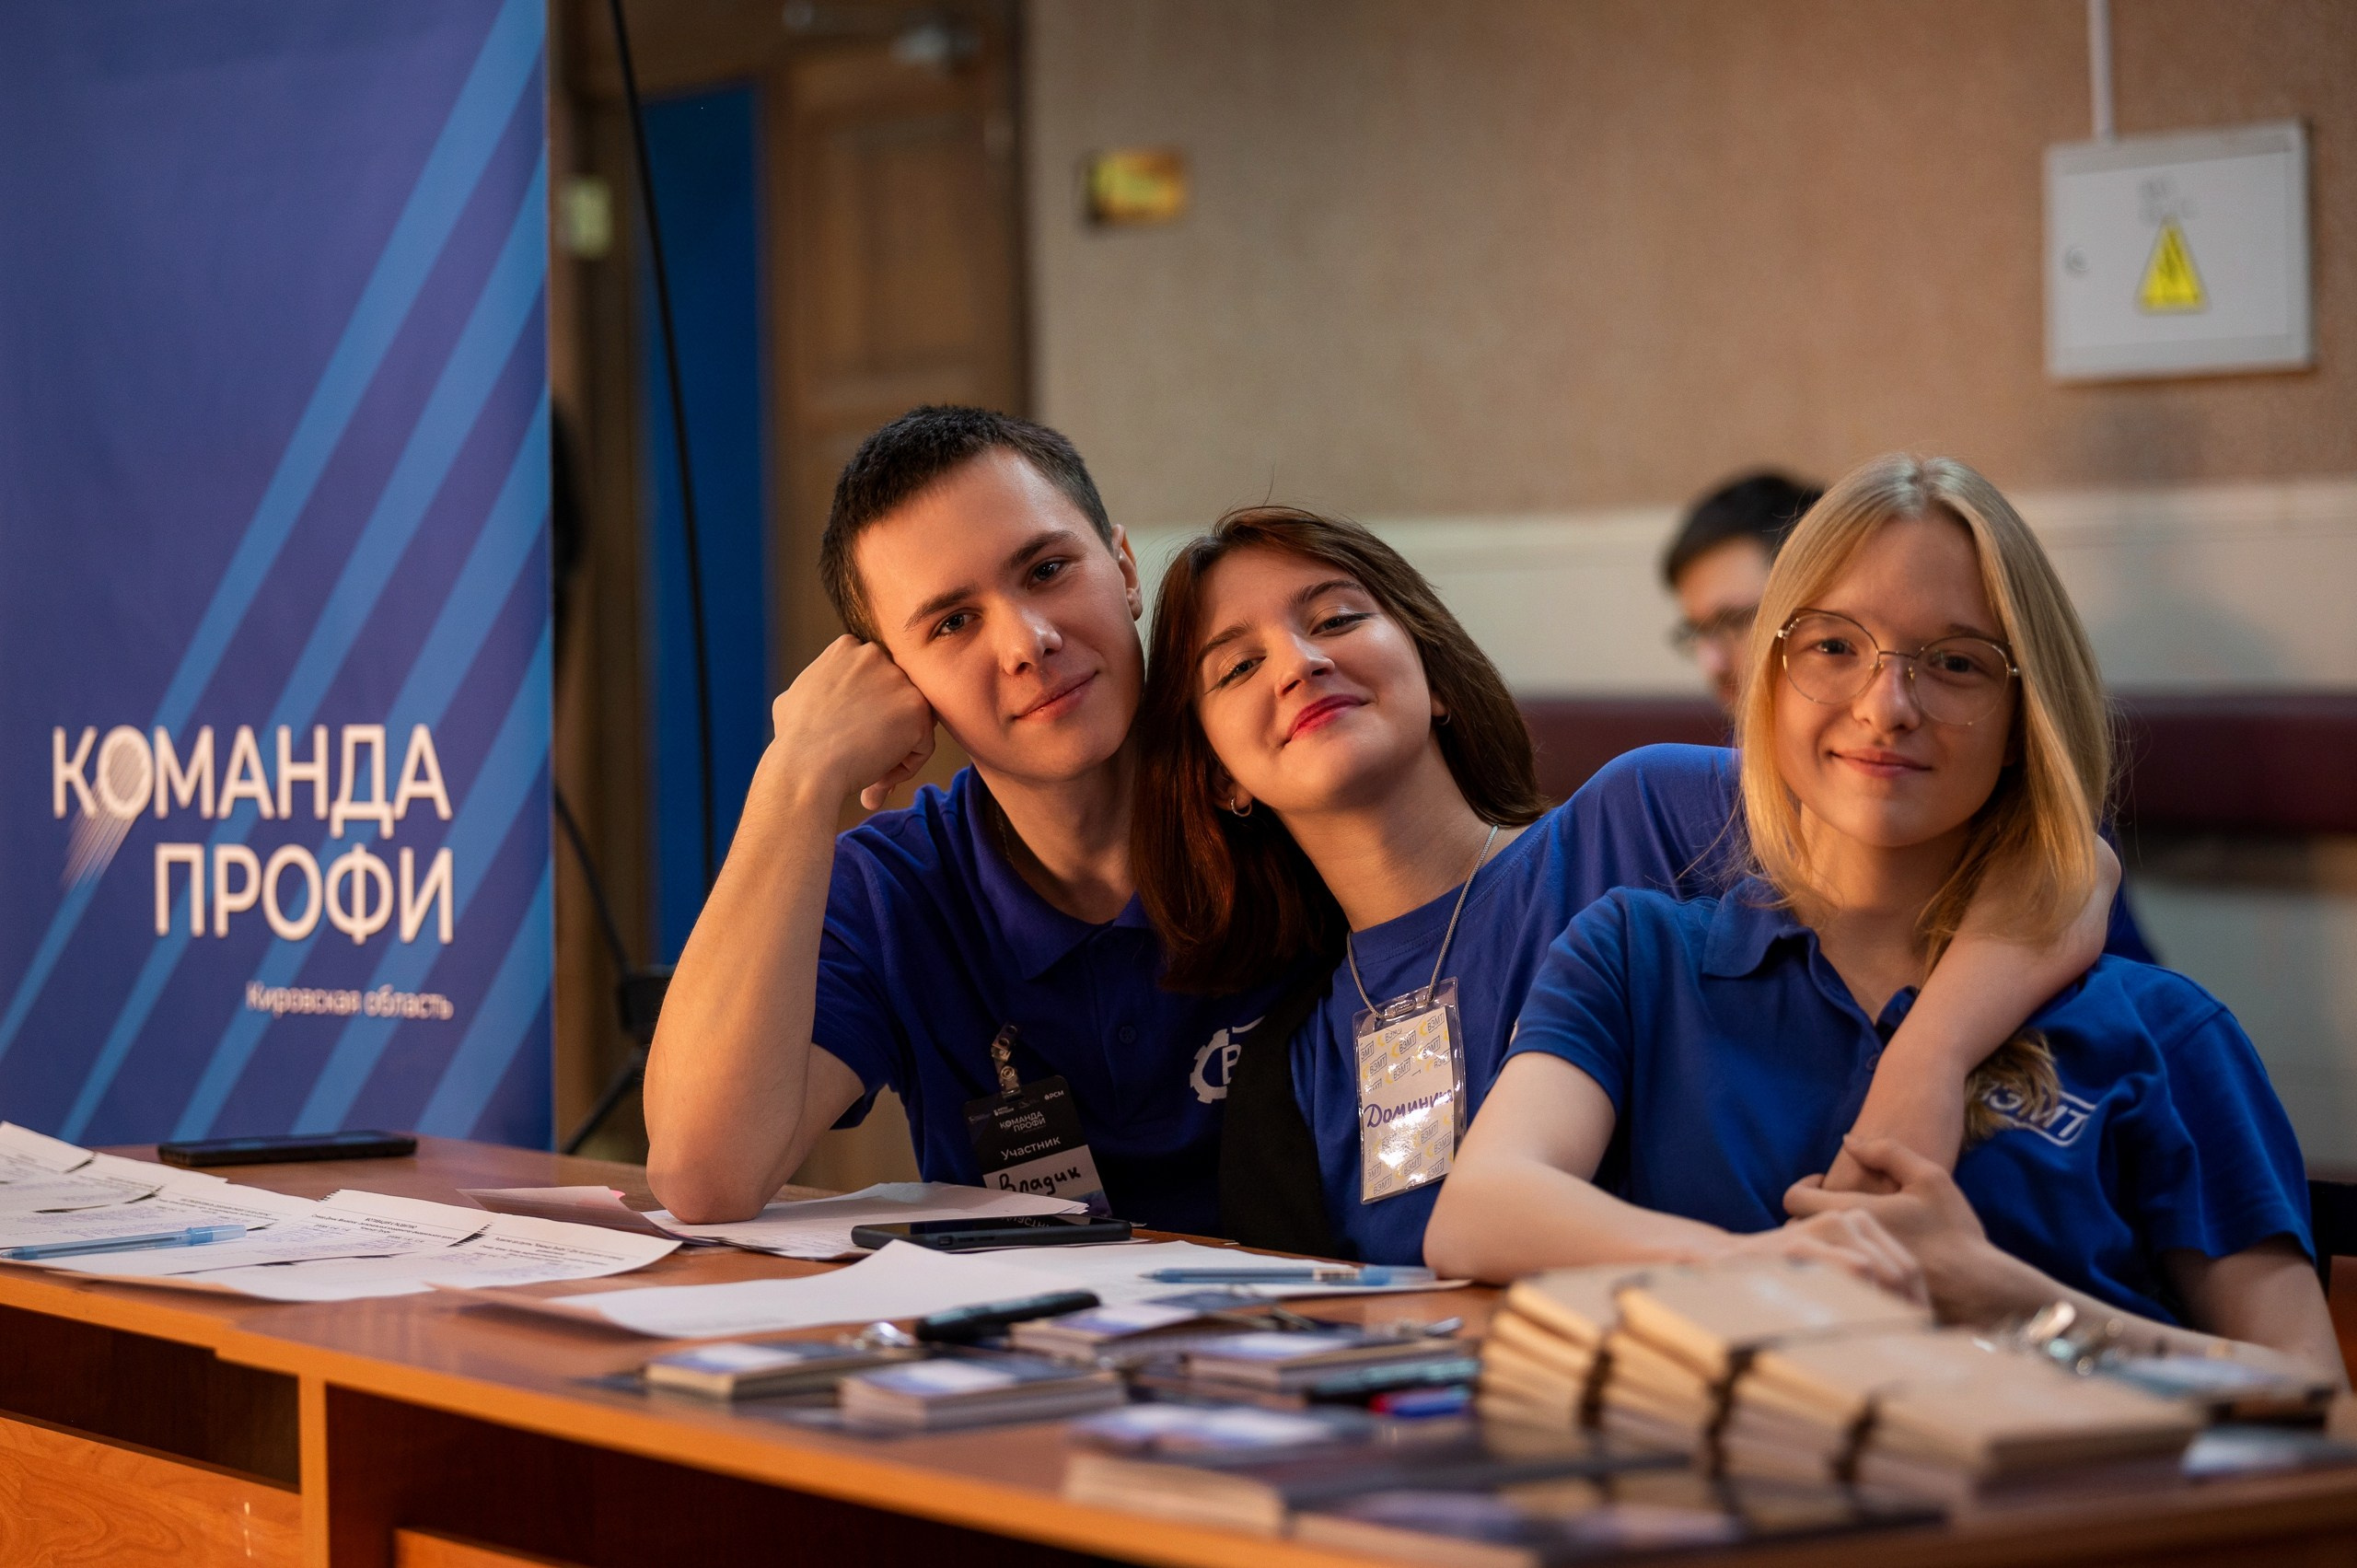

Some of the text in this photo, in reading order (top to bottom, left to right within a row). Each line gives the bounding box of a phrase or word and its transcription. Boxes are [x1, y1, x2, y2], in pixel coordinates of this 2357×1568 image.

[52, 724, 453, 840] КОМАНДА
[154, 842, 454, 945] ПРОФИ
[246, 981, 454, 1021] Кировская область
[999, 1110, 1043, 1129] КОМАНДА
[1013, 1117, 1046, 1132] ПРОФИ
[1001, 1136, 1061, 1160] Участник
